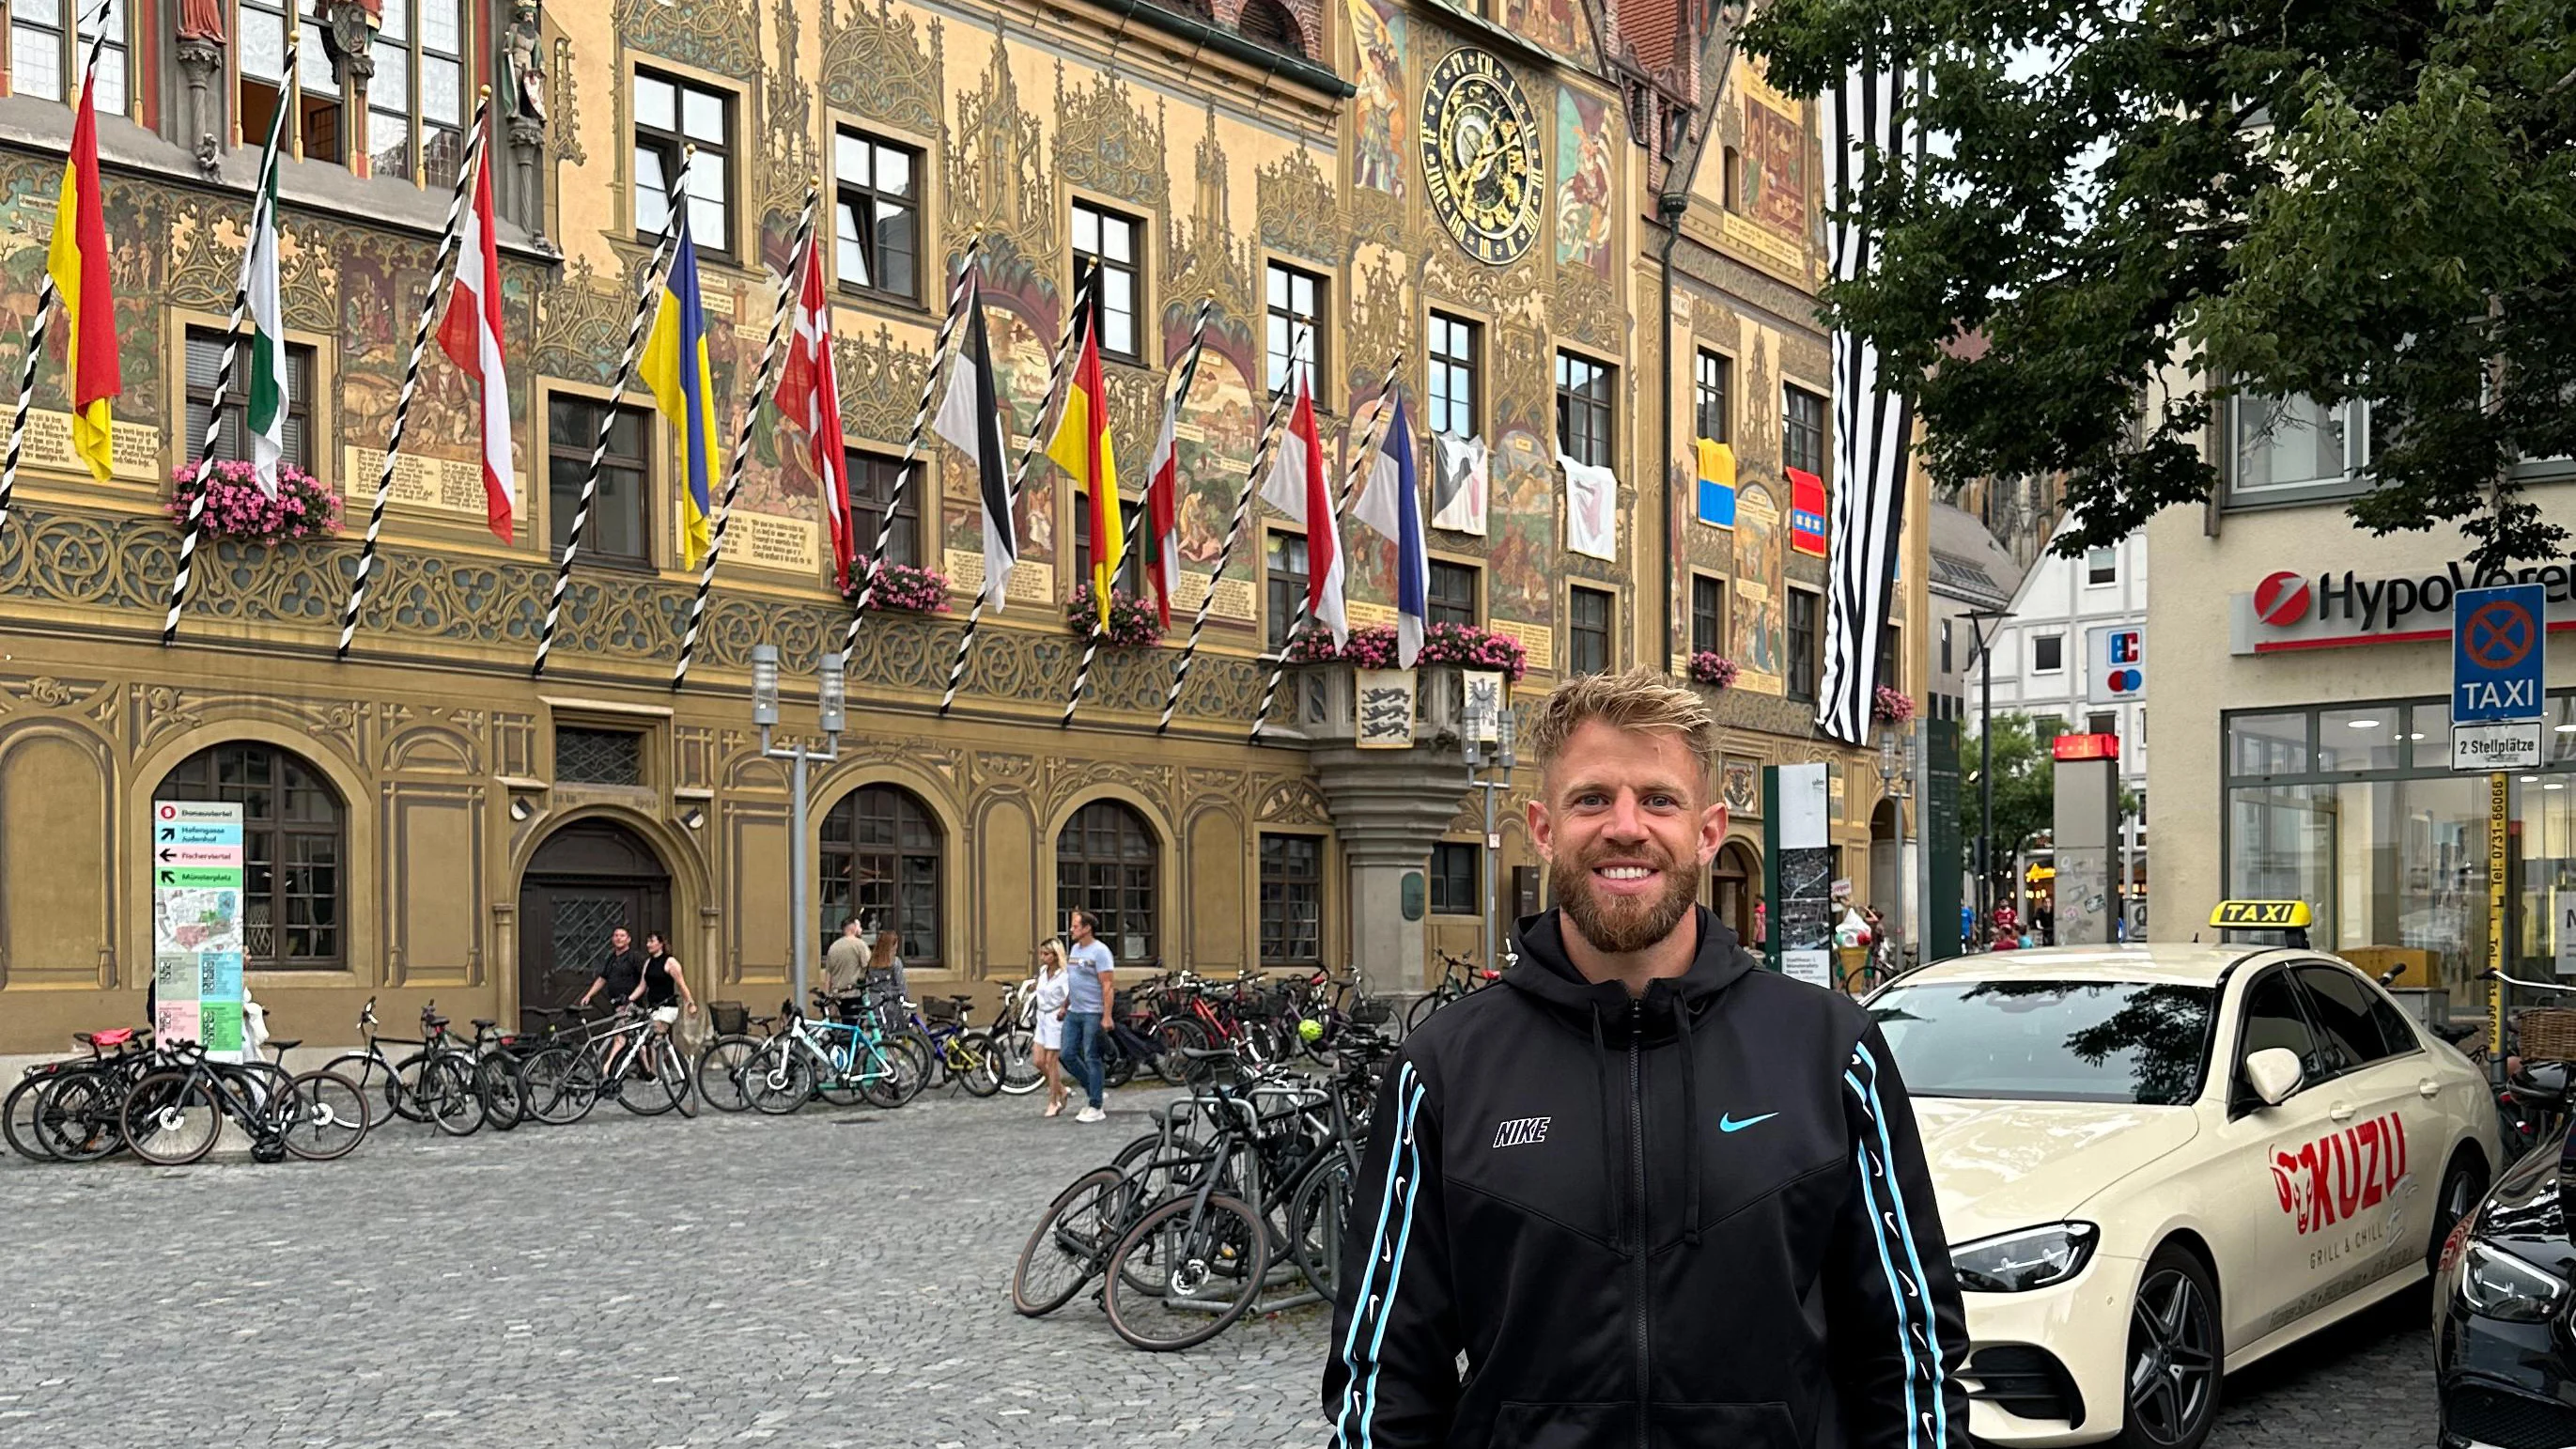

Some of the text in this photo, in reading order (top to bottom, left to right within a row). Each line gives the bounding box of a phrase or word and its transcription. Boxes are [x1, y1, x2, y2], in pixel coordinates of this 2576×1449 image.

[2461, 678, 2534, 709] TAXI
[2460, 738, 2535, 756] 2 Stellplätze
[2491, 780, 2504, 888] Tel: 0731-66066
[2227, 904, 2291, 921] TAXI
[1493, 1116, 1552, 1148] NIKE
[2310, 1242, 2340, 1270] GRILL
[2355, 1223, 2382, 1248] CHILL
